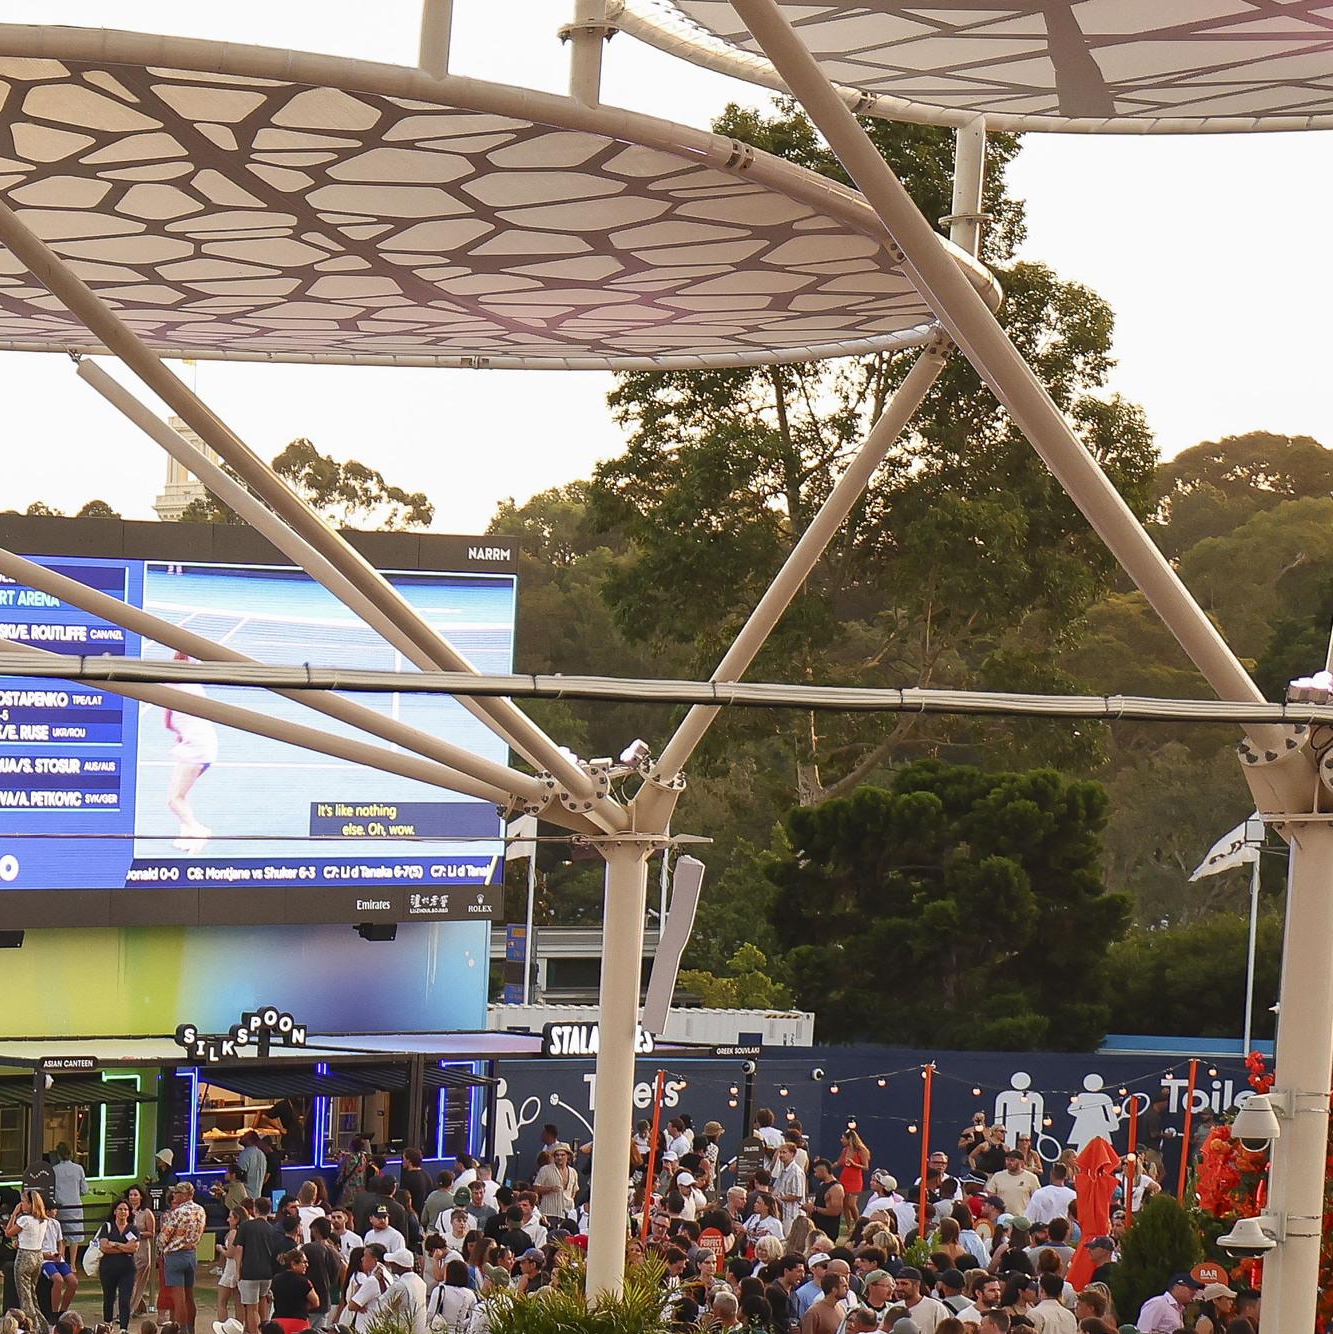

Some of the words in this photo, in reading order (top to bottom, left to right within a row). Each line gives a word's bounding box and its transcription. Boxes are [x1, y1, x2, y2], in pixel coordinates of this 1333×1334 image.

[468, 547, 511, 561] NARRM
[20, 725, 49, 740] RUSE
[34, 758, 81, 774] STOSUR
[31, 792, 82, 807] PETKOVIC
[317, 804, 333, 817] It's
[335, 804, 354, 817] like
[355, 804, 397, 820] nothing
[342, 822, 366, 836] else.
[368, 822, 387, 837] Oh,
[388, 825, 416, 836] wow.
[251, 869, 263, 880] vs
[356, 900, 391, 911] Emirates
[468, 905, 492, 913] ROLEX
[237, 1010, 305, 1045] SPOON
[183, 1028, 236, 1062] SILK
[716, 1046, 734, 1055] GREEK
[43, 1059, 63, 1069] ASIAN
[63, 1058, 94, 1068] CANTEEN
[1200, 1269, 1217, 1278] BAR
